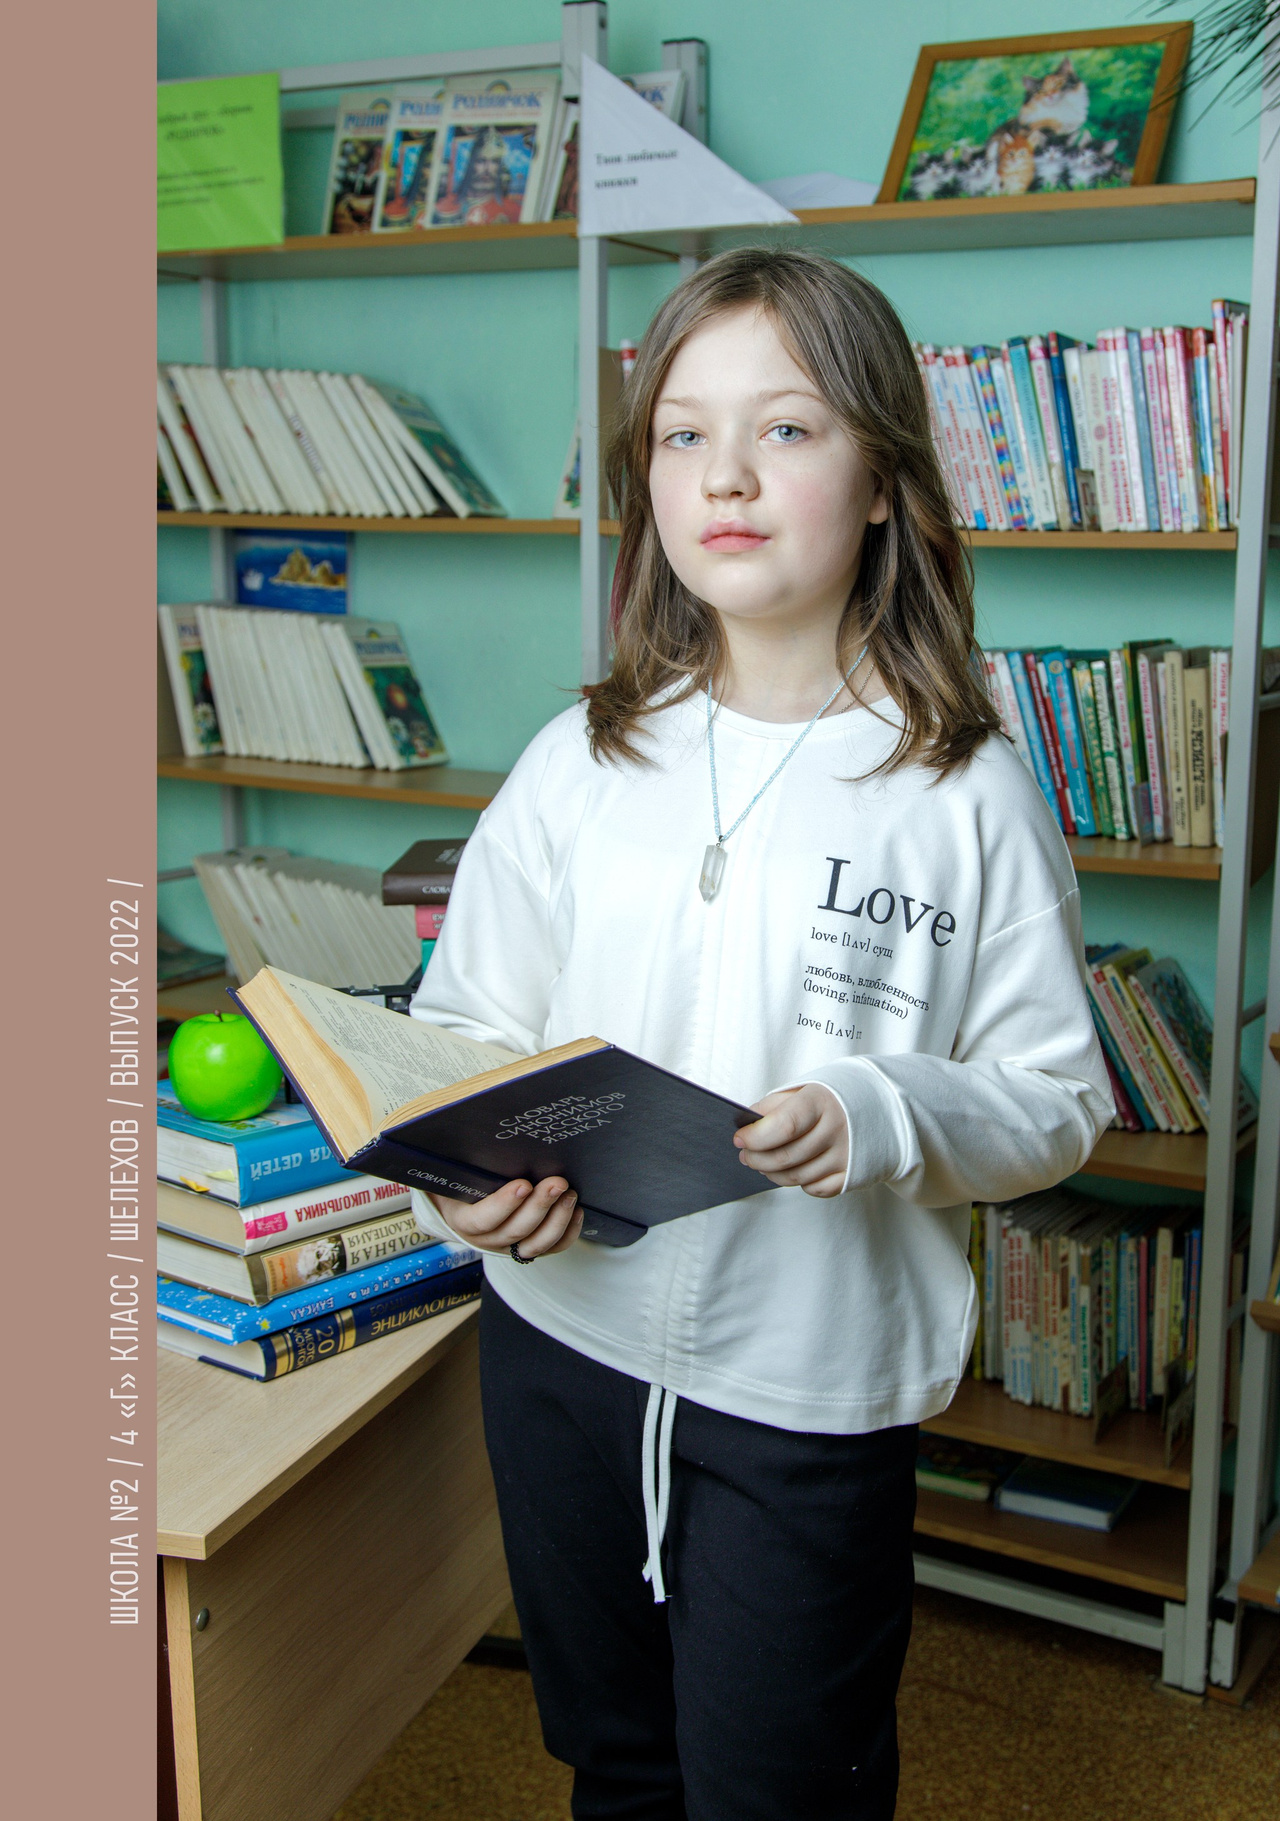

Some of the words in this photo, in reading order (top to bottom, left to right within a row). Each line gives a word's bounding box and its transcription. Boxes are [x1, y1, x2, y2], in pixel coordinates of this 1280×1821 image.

[817, 857, 957, 947] Love
[811, 927, 838, 943] love
[872, 945, 894, 959] сущ
[803, 978, 849, 1003] (loving,
[805, 965, 855, 986] любовь,
[857, 977, 930, 1011] влюбленность
[797, 1013, 822, 1030] love
[495, 1092, 626, 1140] СИНОНИМОВ
[499, 1095, 586, 1127] СЛОВАРЬ
[526, 1103, 624, 1139] РУССКОГО
[542, 1118, 612, 1145] ЯЗЫКА
[250, 1152, 304, 1181] ДЕТЕЙ
[407, 1168, 448, 1186] СЛОВАРЬ
[294, 1190, 371, 1223] ШКОЛЬНИКА
[290, 1297, 335, 1321] БАЙКАЛ
[315, 1325, 335, 1354] 20
